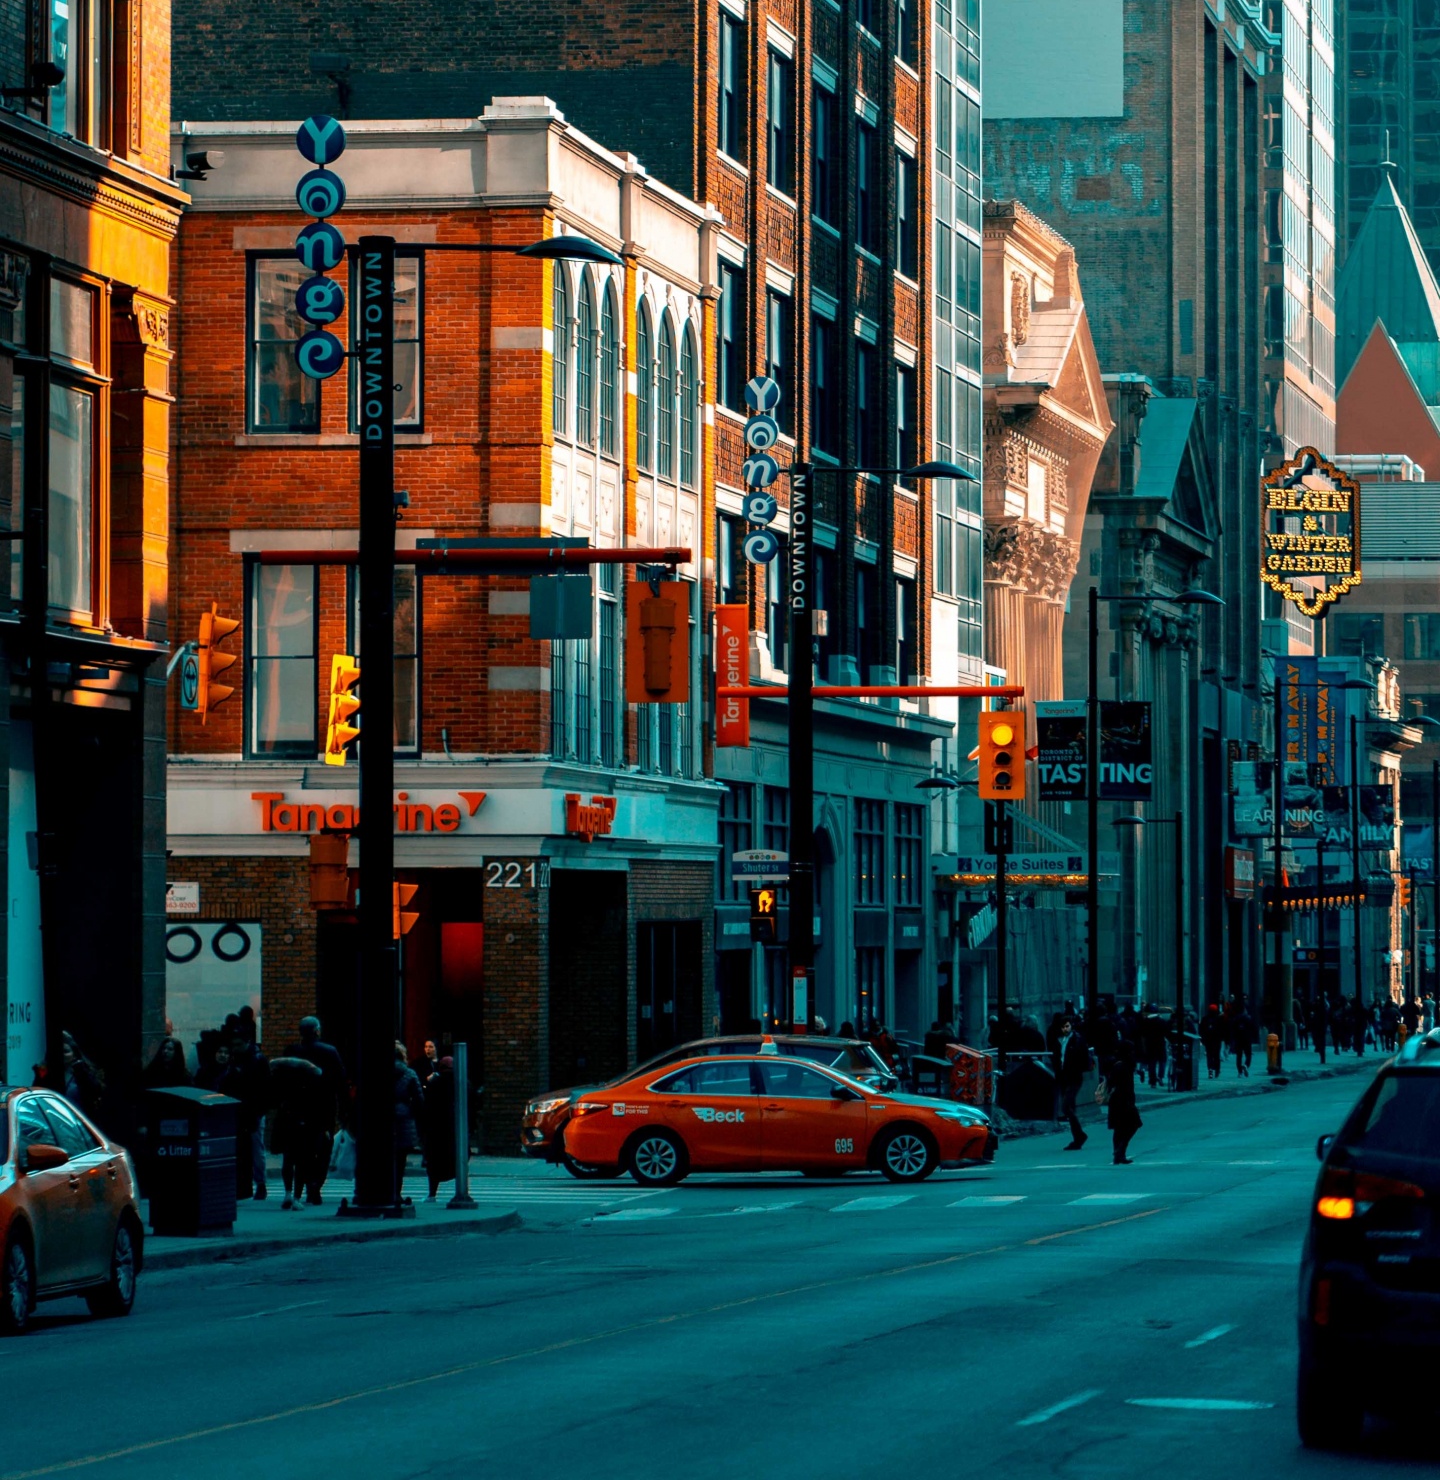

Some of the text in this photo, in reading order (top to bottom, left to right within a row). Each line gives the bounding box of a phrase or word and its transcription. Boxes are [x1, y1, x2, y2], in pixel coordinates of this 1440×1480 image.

[296, 115, 345, 378] Yonge
[365, 252, 383, 440] DOWNTOWN
[743, 377, 780, 563] Yonge
[1267, 488, 1351, 512] ELGIN
[1303, 515, 1319, 531] &
[792, 473, 807, 607] DOWNTOWN
[1267, 534, 1352, 552] WINTER
[1267, 554, 1352, 573] GARDEN
[1287, 663, 1299, 711] AWAY
[1317, 678, 1329, 724] AWAY
[486, 861, 536, 888] 221
[742, 863, 770, 873] Shuter
[1021, 858, 1065, 870] Suites
[696, 1107, 745, 1123] Beck
[168, 1144, 192, 1157] Litter
[835, 1137, 854, 1154] 695
